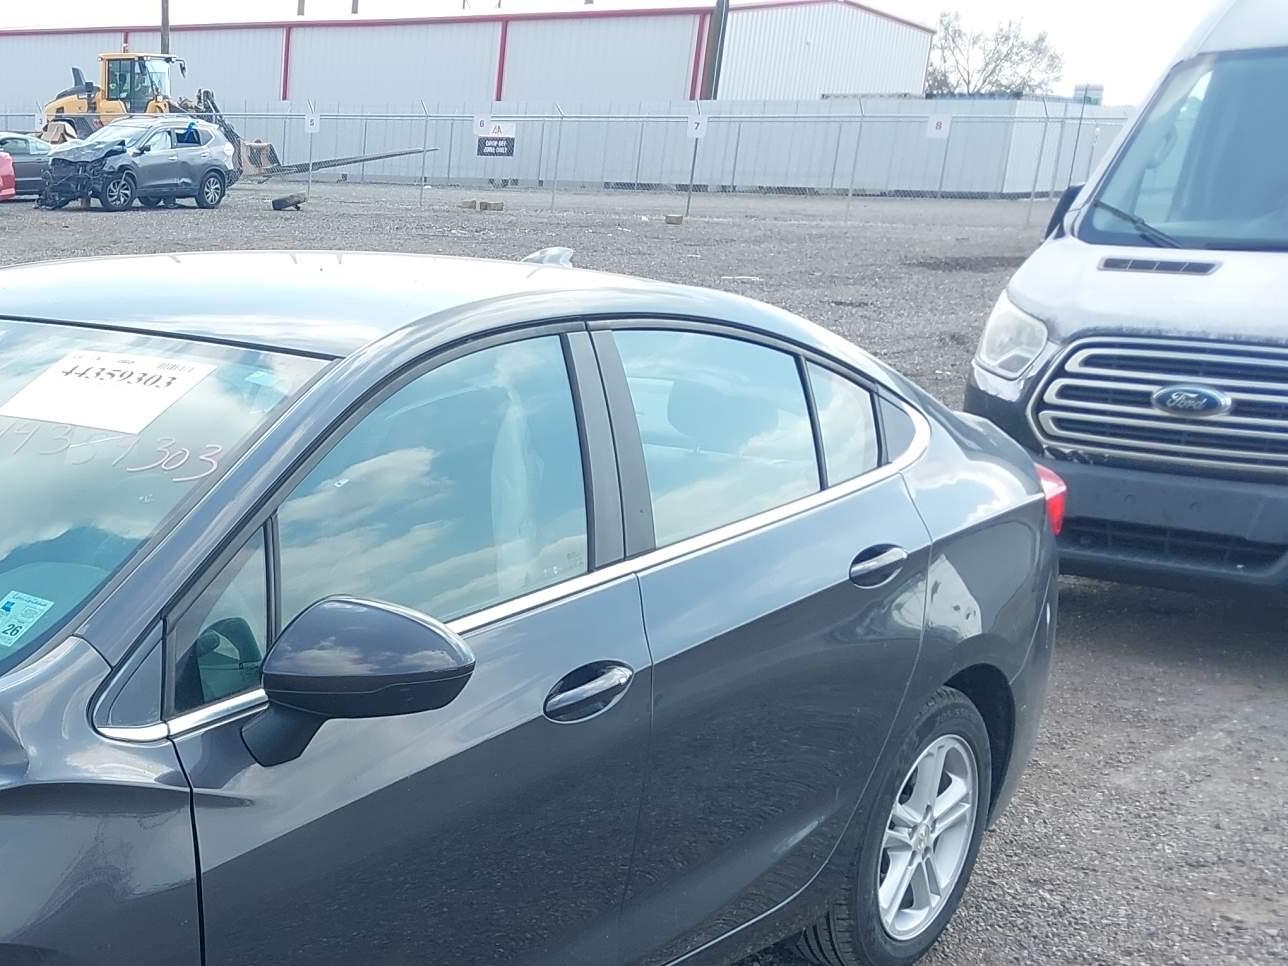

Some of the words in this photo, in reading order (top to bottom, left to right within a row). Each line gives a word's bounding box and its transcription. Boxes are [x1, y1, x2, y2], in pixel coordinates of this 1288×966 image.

[694, 121, 700, 130] 7
[935, 120, 943, 130] 8
[61, 364, 177, 389] 44359303
[1166, 391, 1208, 410] Ford
[2, 623, 23, 637] 26
